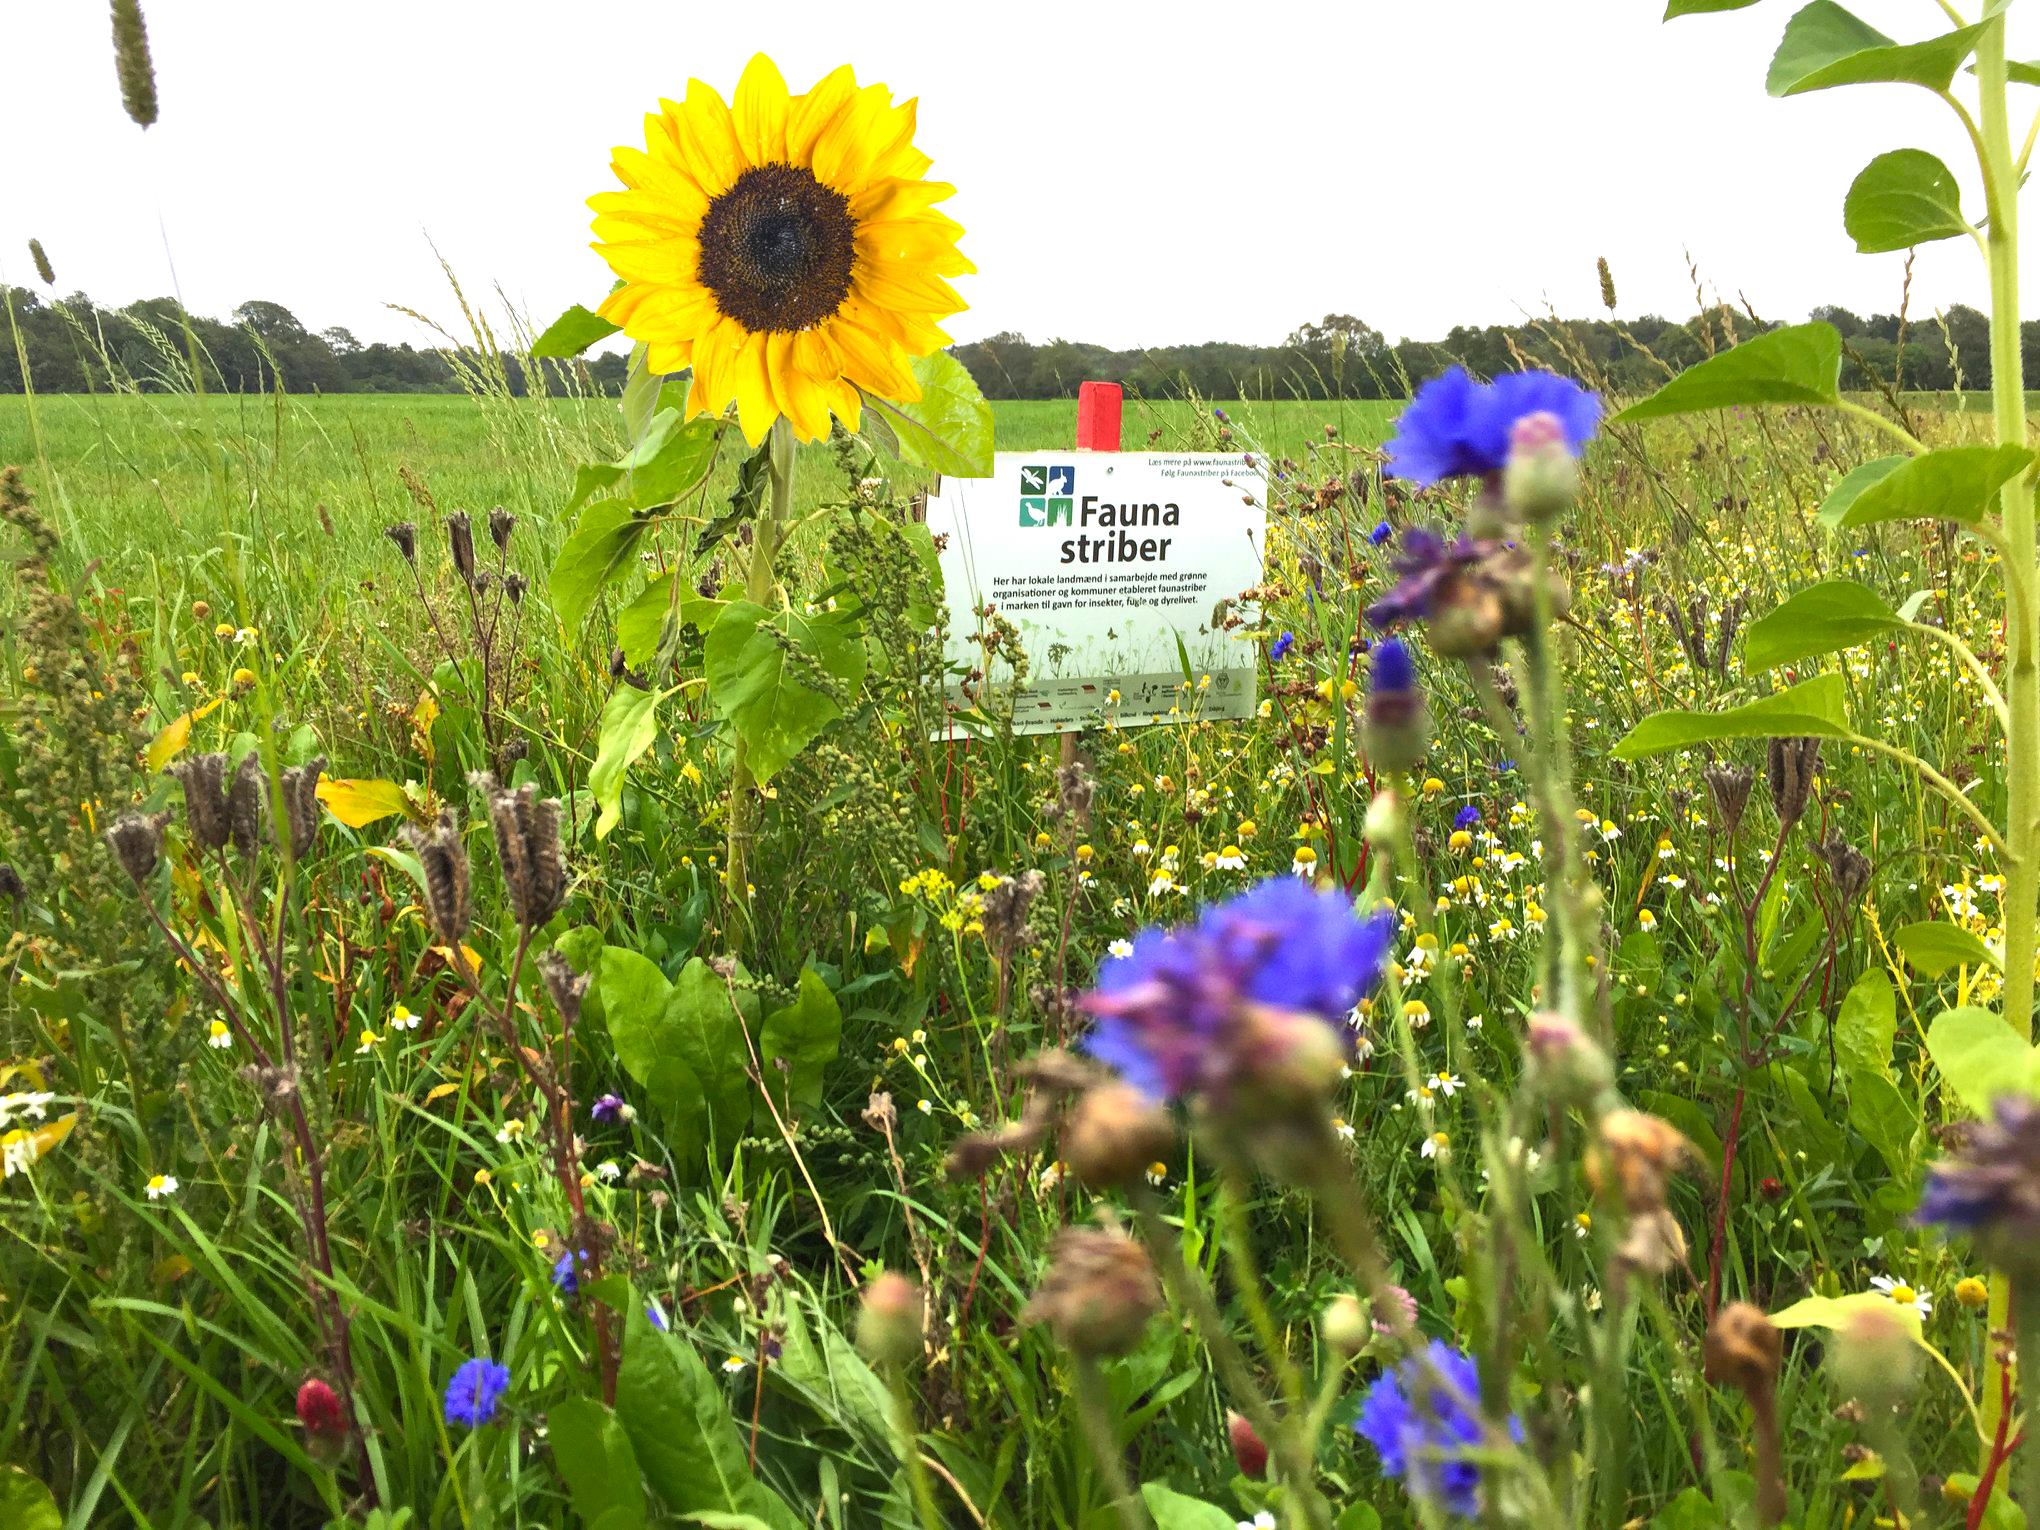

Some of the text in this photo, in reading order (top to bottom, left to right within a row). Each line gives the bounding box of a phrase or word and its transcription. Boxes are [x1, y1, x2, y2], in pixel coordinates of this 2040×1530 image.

[1183, 459, 1191, 467] på
[1161, 469, 1175, 478] Følg
[1221, 469, 1229, 478] på
[1081, 495, 1179, 527] Fauna
[1061, 530, 1171, 563] striber
[994, 577, 1010, 586] Her
[1012, 577, 1026, 585] har
[1029, 576, 1054, 584] lokale
[1057, 575, 1102, 583] landmænd
[1110, 573, 1157, 583] samarbejde
[1160, 572, 1177, 580] med
[1179, 573, 1207, 581] grønne
[993, 584, 1206, 599] organisationer og kommuner etableret faunastriber
[1006, 601, 1039, 610] marken
[1041, 600, 1050, 609] til
[1052, 601, 1073, 610] gavn
[1075, 600, 1086, 608] for
[1089, 598, 1124, 607] insekter,
[1127, 597, 1147, 607] fugle
[1149, 598, 1159, 606] og
[1161, 596, 1198, 605] dyrelivet.
